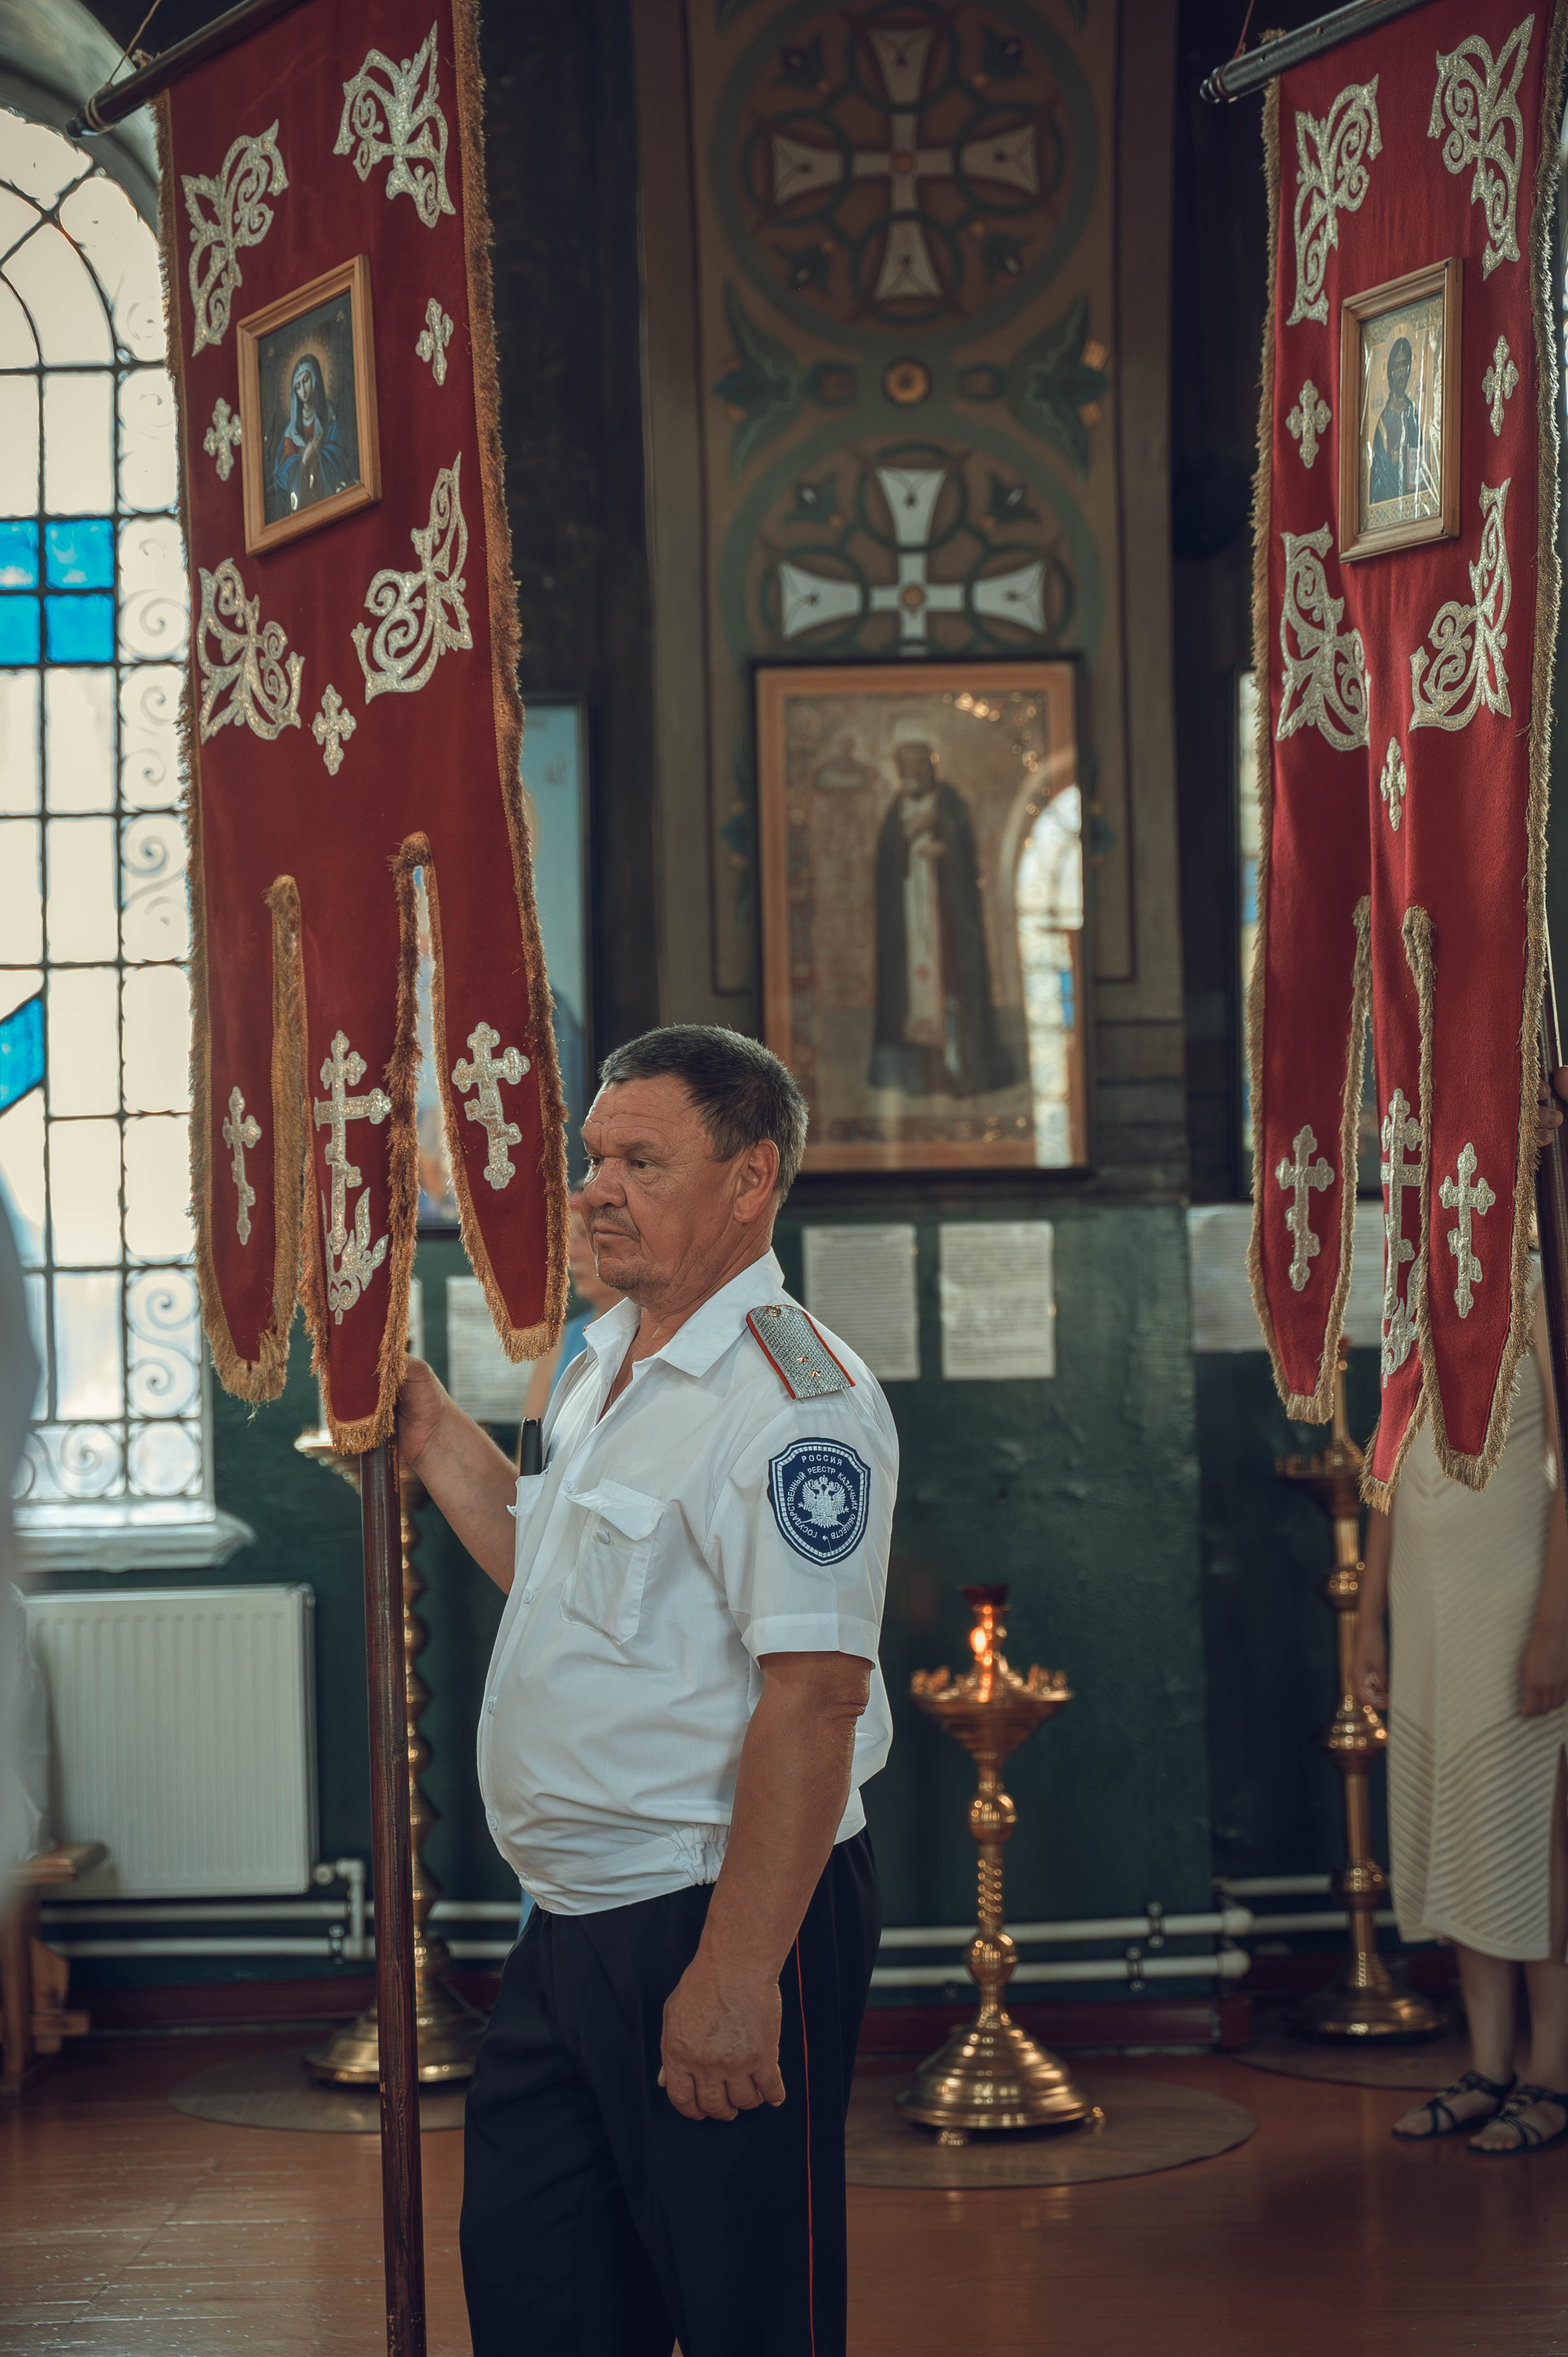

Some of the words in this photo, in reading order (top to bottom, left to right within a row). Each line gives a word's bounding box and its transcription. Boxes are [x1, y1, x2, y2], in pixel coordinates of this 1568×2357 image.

[801, 1454, 843, 1466] РОССИЯ
[807, 1466, 836, 1475] РЕЕСТР
[837, 1473, 858, 1510] КАЗАЧЬИХ
[787, 1471, 818, 1538] ГОСУДАРСТВЕННЫЙ
[831, 1514, 856, 1539] ОБЩЕСТВ
